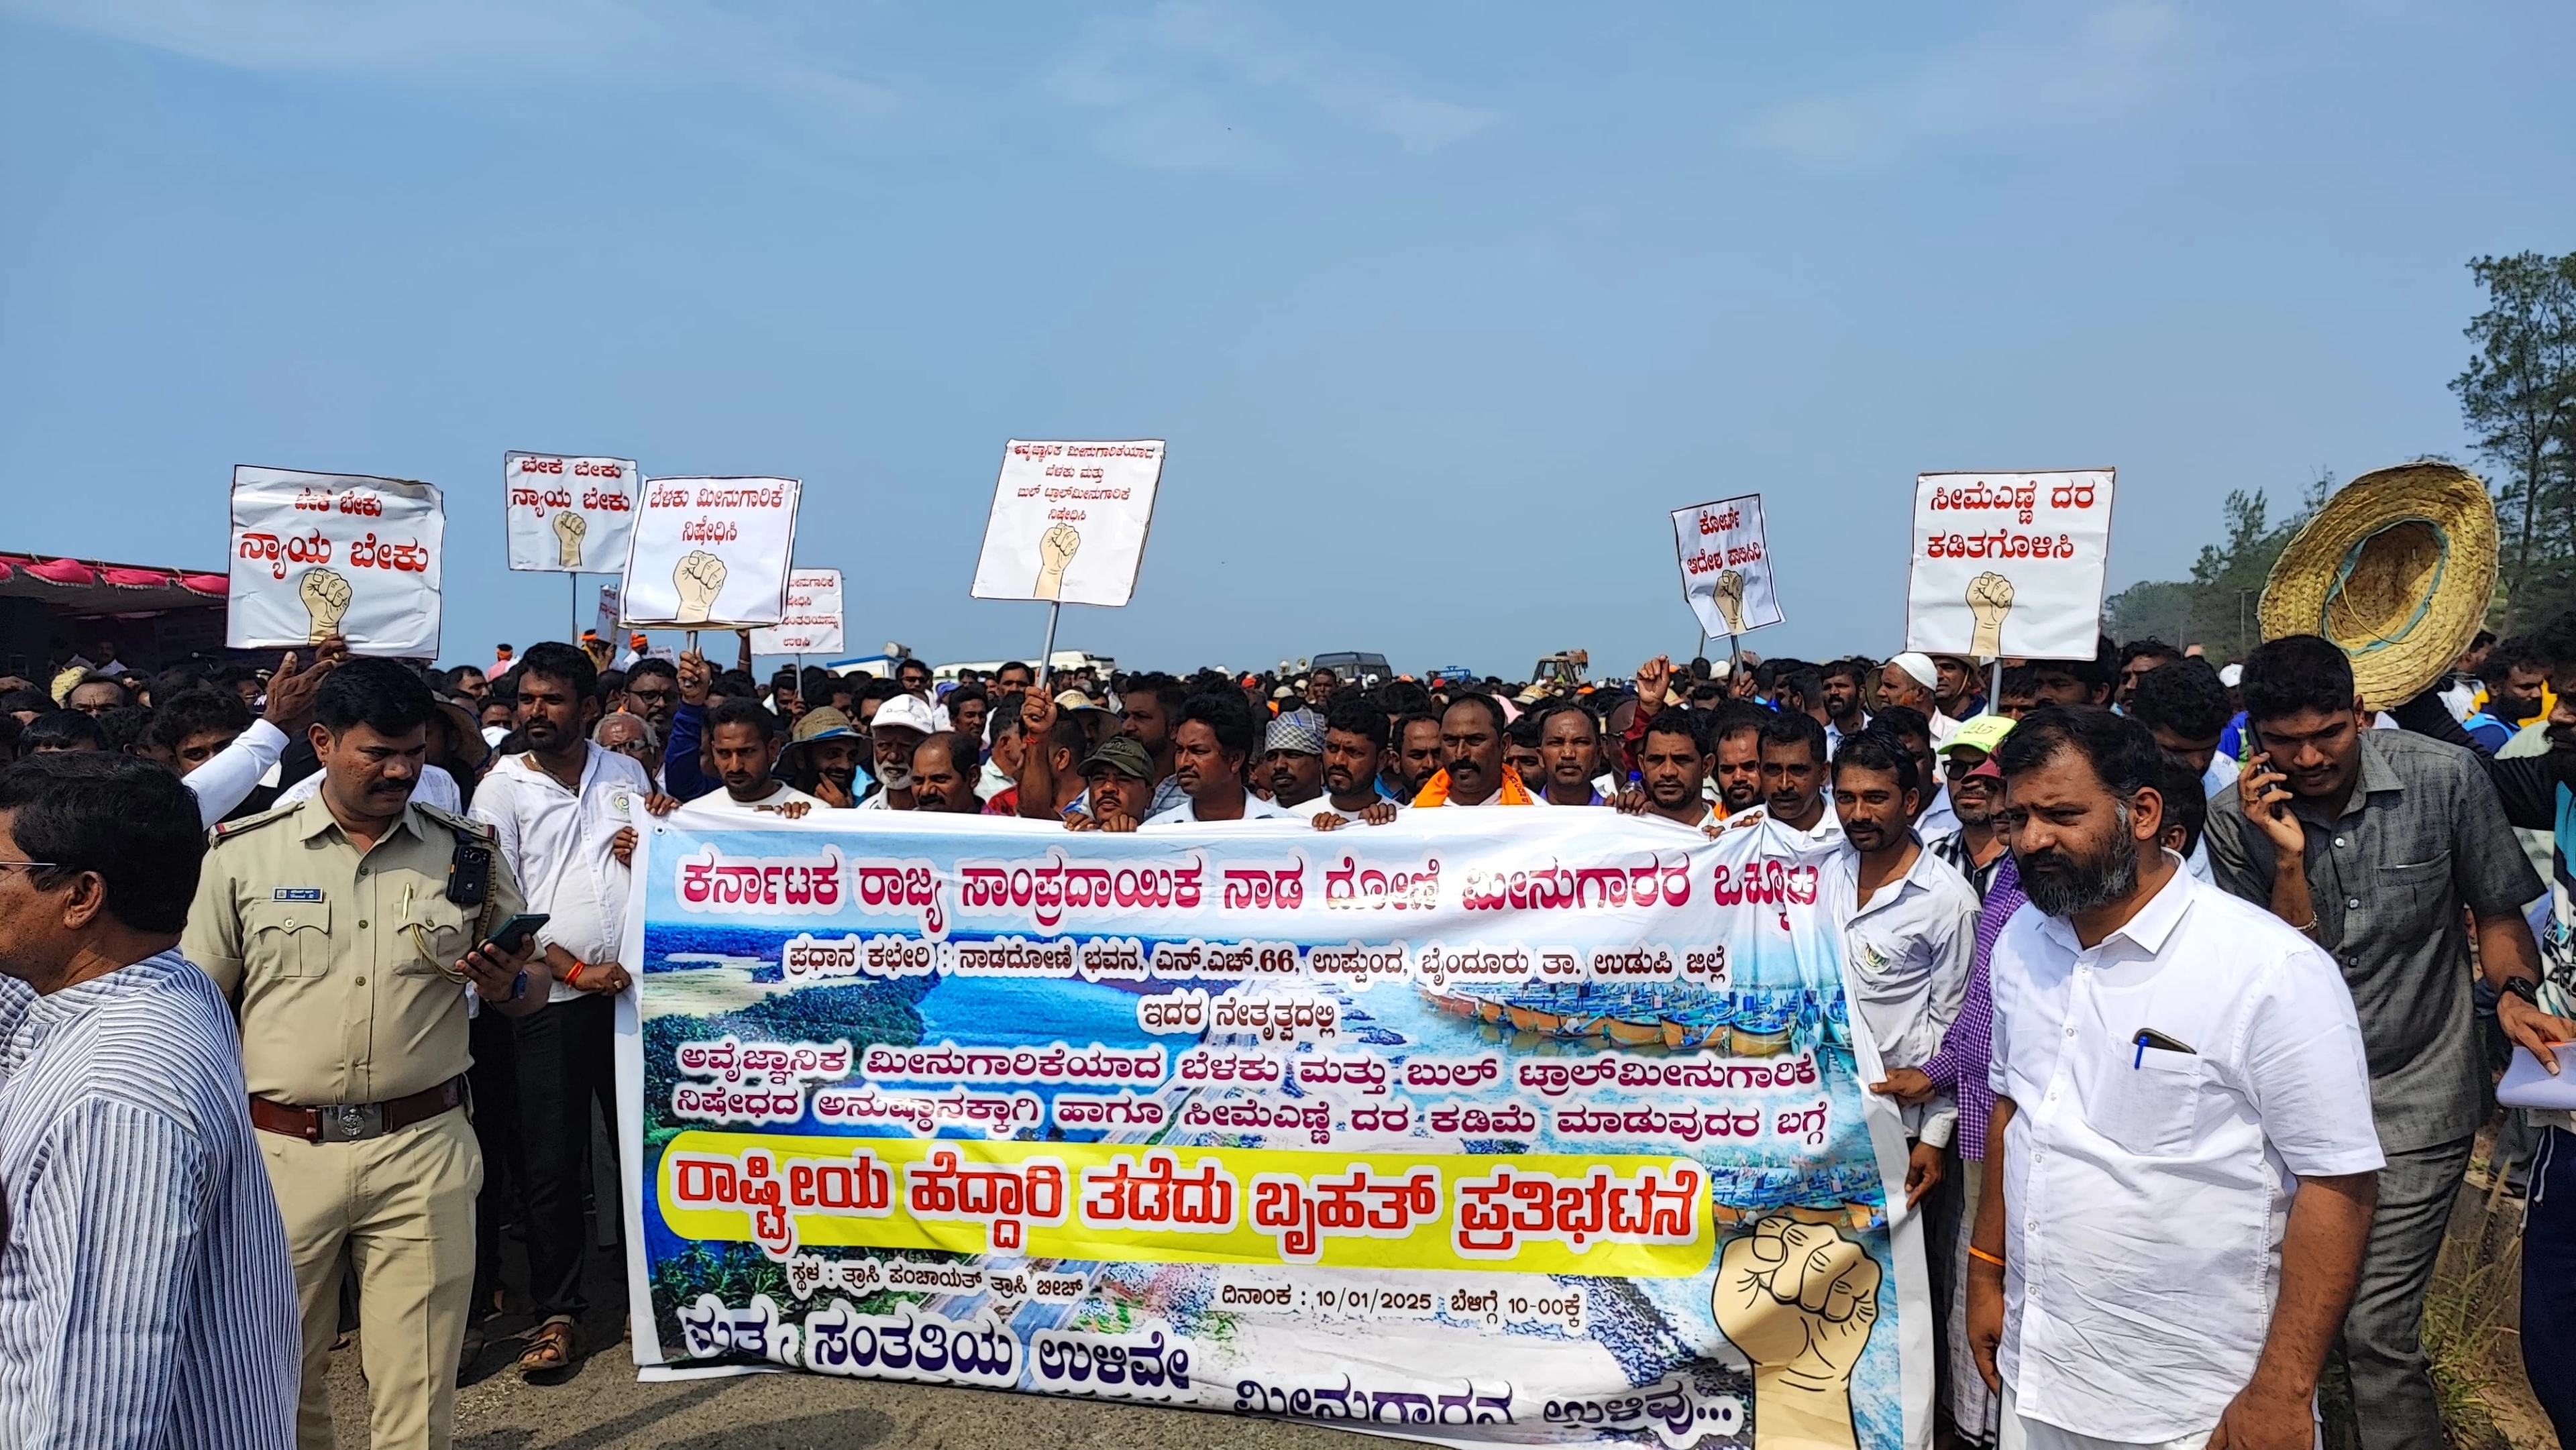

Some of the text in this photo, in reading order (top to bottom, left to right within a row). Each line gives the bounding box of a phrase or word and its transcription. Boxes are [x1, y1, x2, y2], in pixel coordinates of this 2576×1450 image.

[574, 461, 623, 479] ಬೇಕು
[1046, 464, 1104, 483] ಬೆಳಕು ಮತ್ತು
[340, 490, 382, 516] ಬೇಕು
[513, 485, 630, 518] ನ್ಯಾಯ ಬೇಕು
[650, 483, 785, 508] ಬೆಳಕು ಮೀನುಗಾರಿಕೆ
[1931, 479, 2096, 524] ಸೀಮೆಎಣ್ಣೆ ದರ
[682, 516, 737, 545] ನಿಷೇಧಿಸಿ
[1927, 528, 2074, 558] ಕಡಿತಗೊಳಿಸಿ
[239, 528, 429, 579] ನ್ಯಾಯ ಬೇಕು
[1687, 548, 1723, 574] ಆದೇಶ
[684, 852, 839, 905] ಕರ್ನಾಟಕ
[859, 867, 942, 933] ರಾಜ್ಯ
[962, 854, 1202, 927] ಸಾಂಪ್ರದಾಯಿಕ
[1224, 855, 1303, 909] ನಾಡ
[1462, 852, 1690, 910] ಮೀನುಗಾರರ
[790, 941, 855, 974] ಪ್ರಧಾನ
[868, 942, 930, 971] ಕಛೇರಿ
[960, 943, 1072, 970] ನಾಡದೋಣಿ
[1084, 945, 1143, 974] ಭವನ,
[1313, 946, 1407, 983] ಉಪ್ಪುಂದ,
[1421, 947, 1528, 986] ಬೈಂದೂರು
[1543, 953, 1580, 975] ತಾ.
[1595, 946, 1673, 974] ಉಡುಪಿ
[1686, 945, 1725, 984] ಜಿಲ್ಲೆ
[1144, 996, 1335, 1041] ಇದರ ನೇತೃತ್ವದಲ್ಲಿ
[682, 1043, 847, 1085] ಅವೈಜ್ಞಾನಿಕ
[867, 1048, 1161, 1079] ಮೀನುಗಾರಿಕೆಯಾದ
[1182, 1050, 1279, 1081] ಬೆಳಕು
[1300, 1054, 1387, 1095] ಮತ್ತು
[1407, 1058, 1497, 1086] ಬುಲ್
[678, 1086, 1827, 1146] ನಿಷೇಧದ ಅನುಷ್ಠಾನಕ್ಕಾಗಿ ಹಾಗೂ ಸೀಮೆಎಣ್ಣೆ ದರ ಕಡಿಮೆ ಮಾಡುವುದರ ಬಗ್ಗೆ
[676, 1151, 1698, 1255] ರಾಷ್ಟ್ರೀಯ ಹೆದ್ದಾರಿ ತಡೆದು ಬೃಹತ್ ಪ್ರತಿಭಟನೆ
[792, 1261, 820, 1291] ಸ್ಥಳ
[842, 1265, 880, 1289] ತ್ರಾಸಿ
[890, 1264, 983, 1288] ಪಂಚಾಯತ್
[990, 1274, 1027, 1298] ತ್ರಾಸಿ
[1036, 1278, 1083, 1296] ಬೀಚ್
[1222, 1284, 1291, 1305] ದಿನಾಂಕ
[1316, 1287, 1432, 1315] 10/01/2025
[1451, 1288, 1498, 1325] ಬೆಳಿಗ್ಗೆ
[1508, 1293, 1580, 1327] 10-00ಕ್ಕೆ
[814, 1308, 1012, 1376] ಸಂತತಿಯ
[1039, 1331, 1190, 1390] ಉಳಿವೇ
